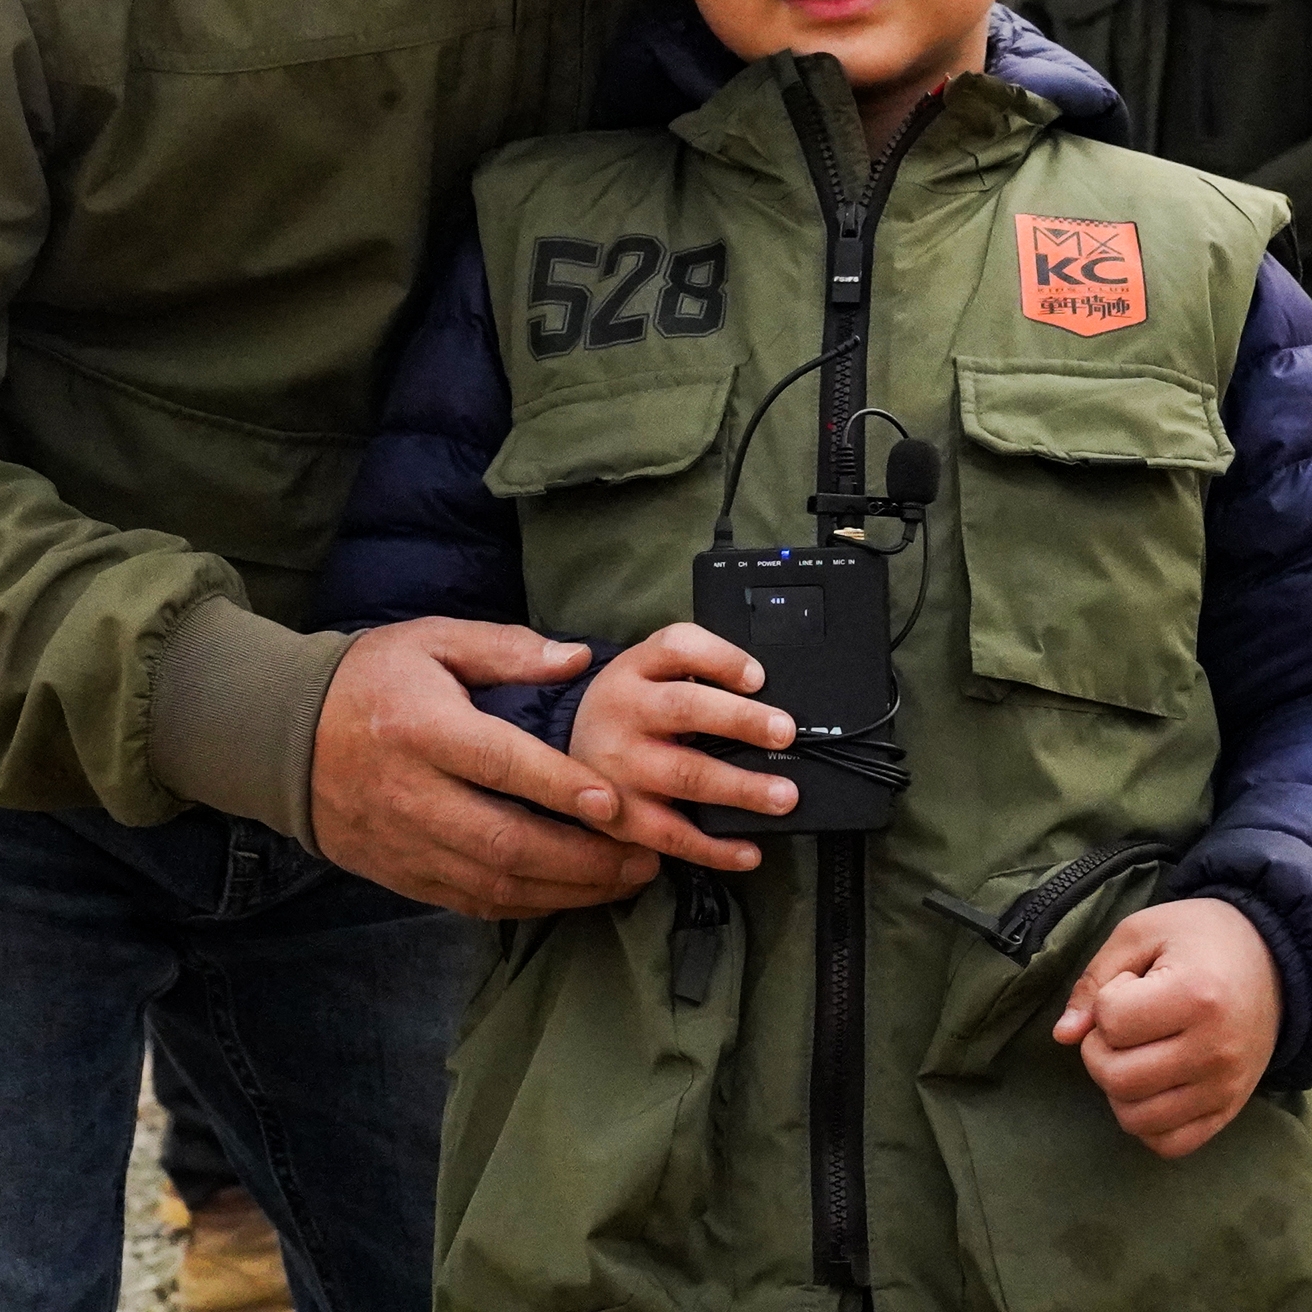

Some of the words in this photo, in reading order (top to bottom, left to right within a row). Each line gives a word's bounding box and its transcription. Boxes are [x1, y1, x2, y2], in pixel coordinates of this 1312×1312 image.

[1035, 253, 1129, 286] KC
[527, 233, 728, 361] 528
[757, 560, 782, 568] POWER
[798, 559, 814, 567] LINE
[815, 559, 824, 567] IN
